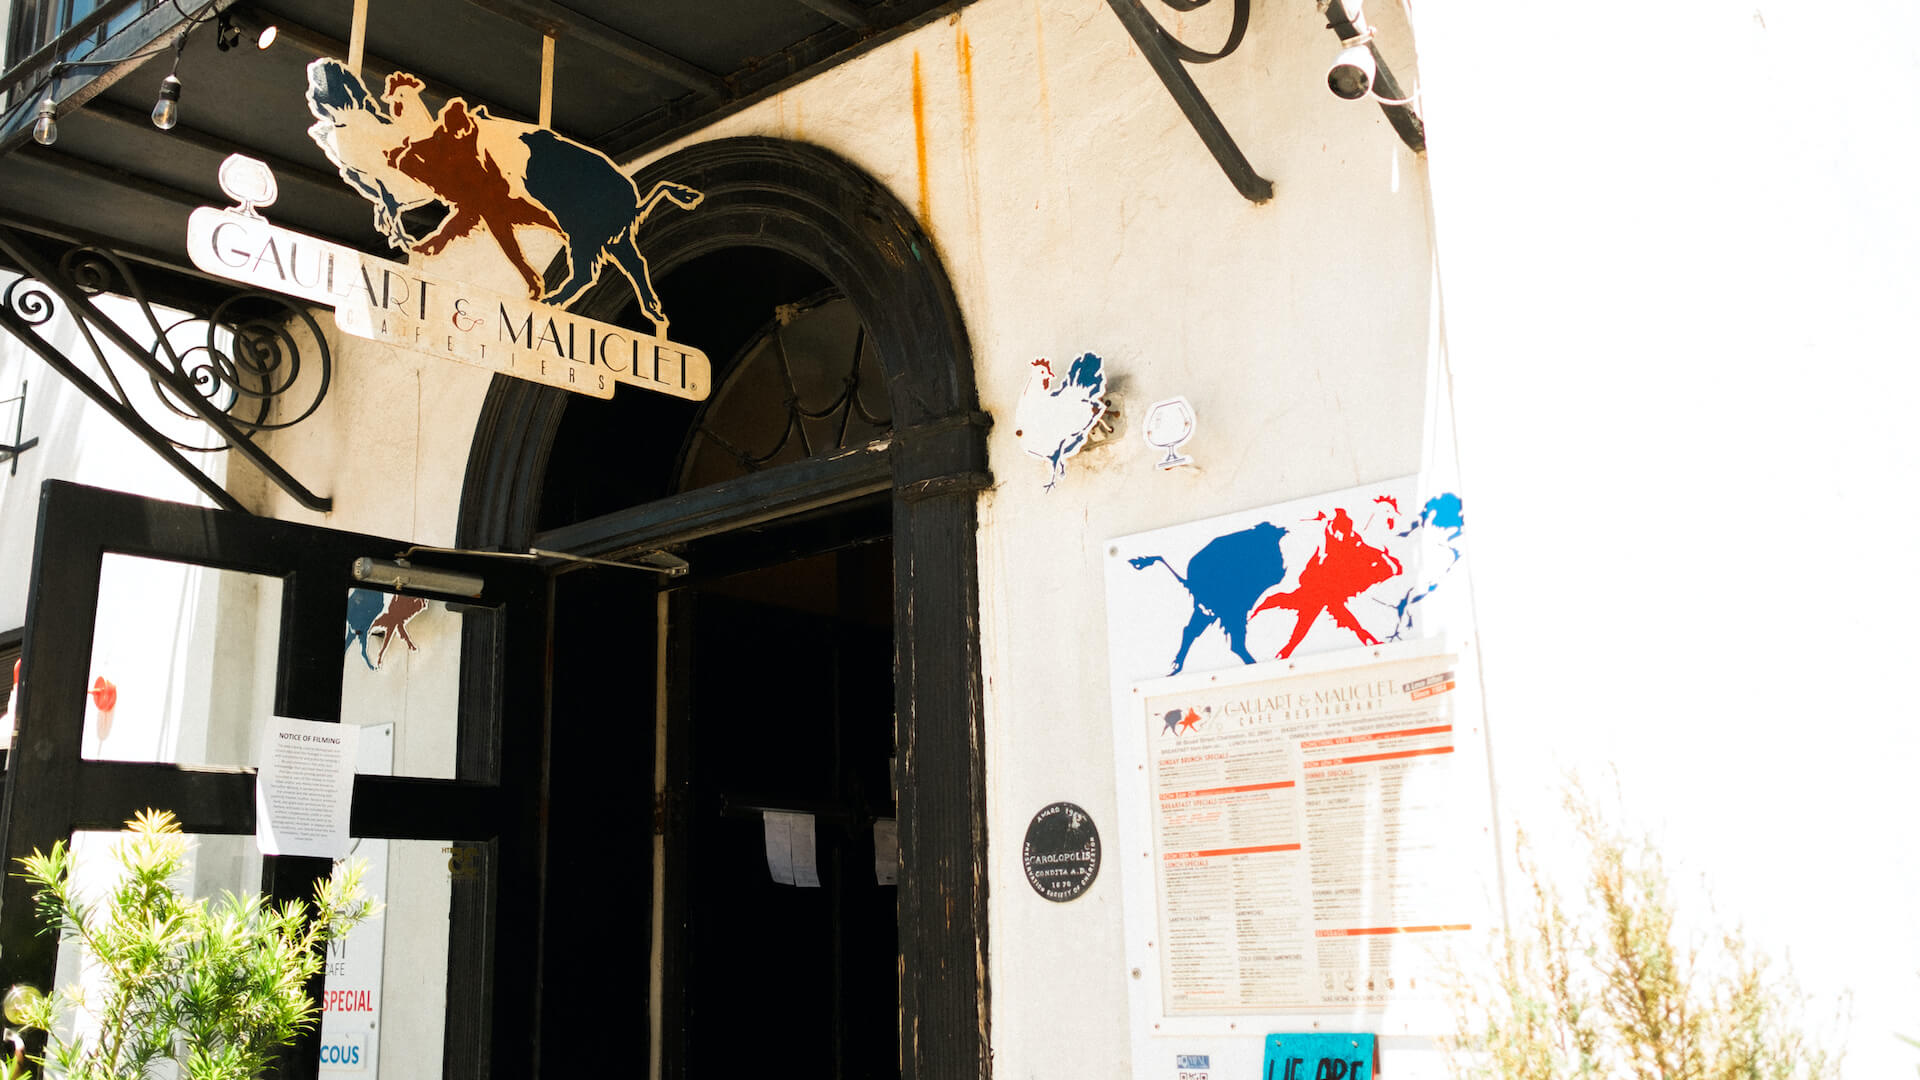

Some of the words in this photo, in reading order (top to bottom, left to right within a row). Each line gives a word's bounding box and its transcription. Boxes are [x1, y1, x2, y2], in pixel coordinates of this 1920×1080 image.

[211, 221, 437, 321] GAULART
[452, 298, 484, 333] &
[279, 732, 301, 742] NOTICE
[302, 735, 312, 743] OF
[312, 736, 341, 745] FILMING
[1036, 806, 1061, 823] AWARD
[1029, 851, 1092, 866] CAROLOPOLIS
[1035, 868, 1068, 878] CONDITA
[322, 989, 373, 1012] SPECIAL
[320, 1045, 360, 1065] COUS
